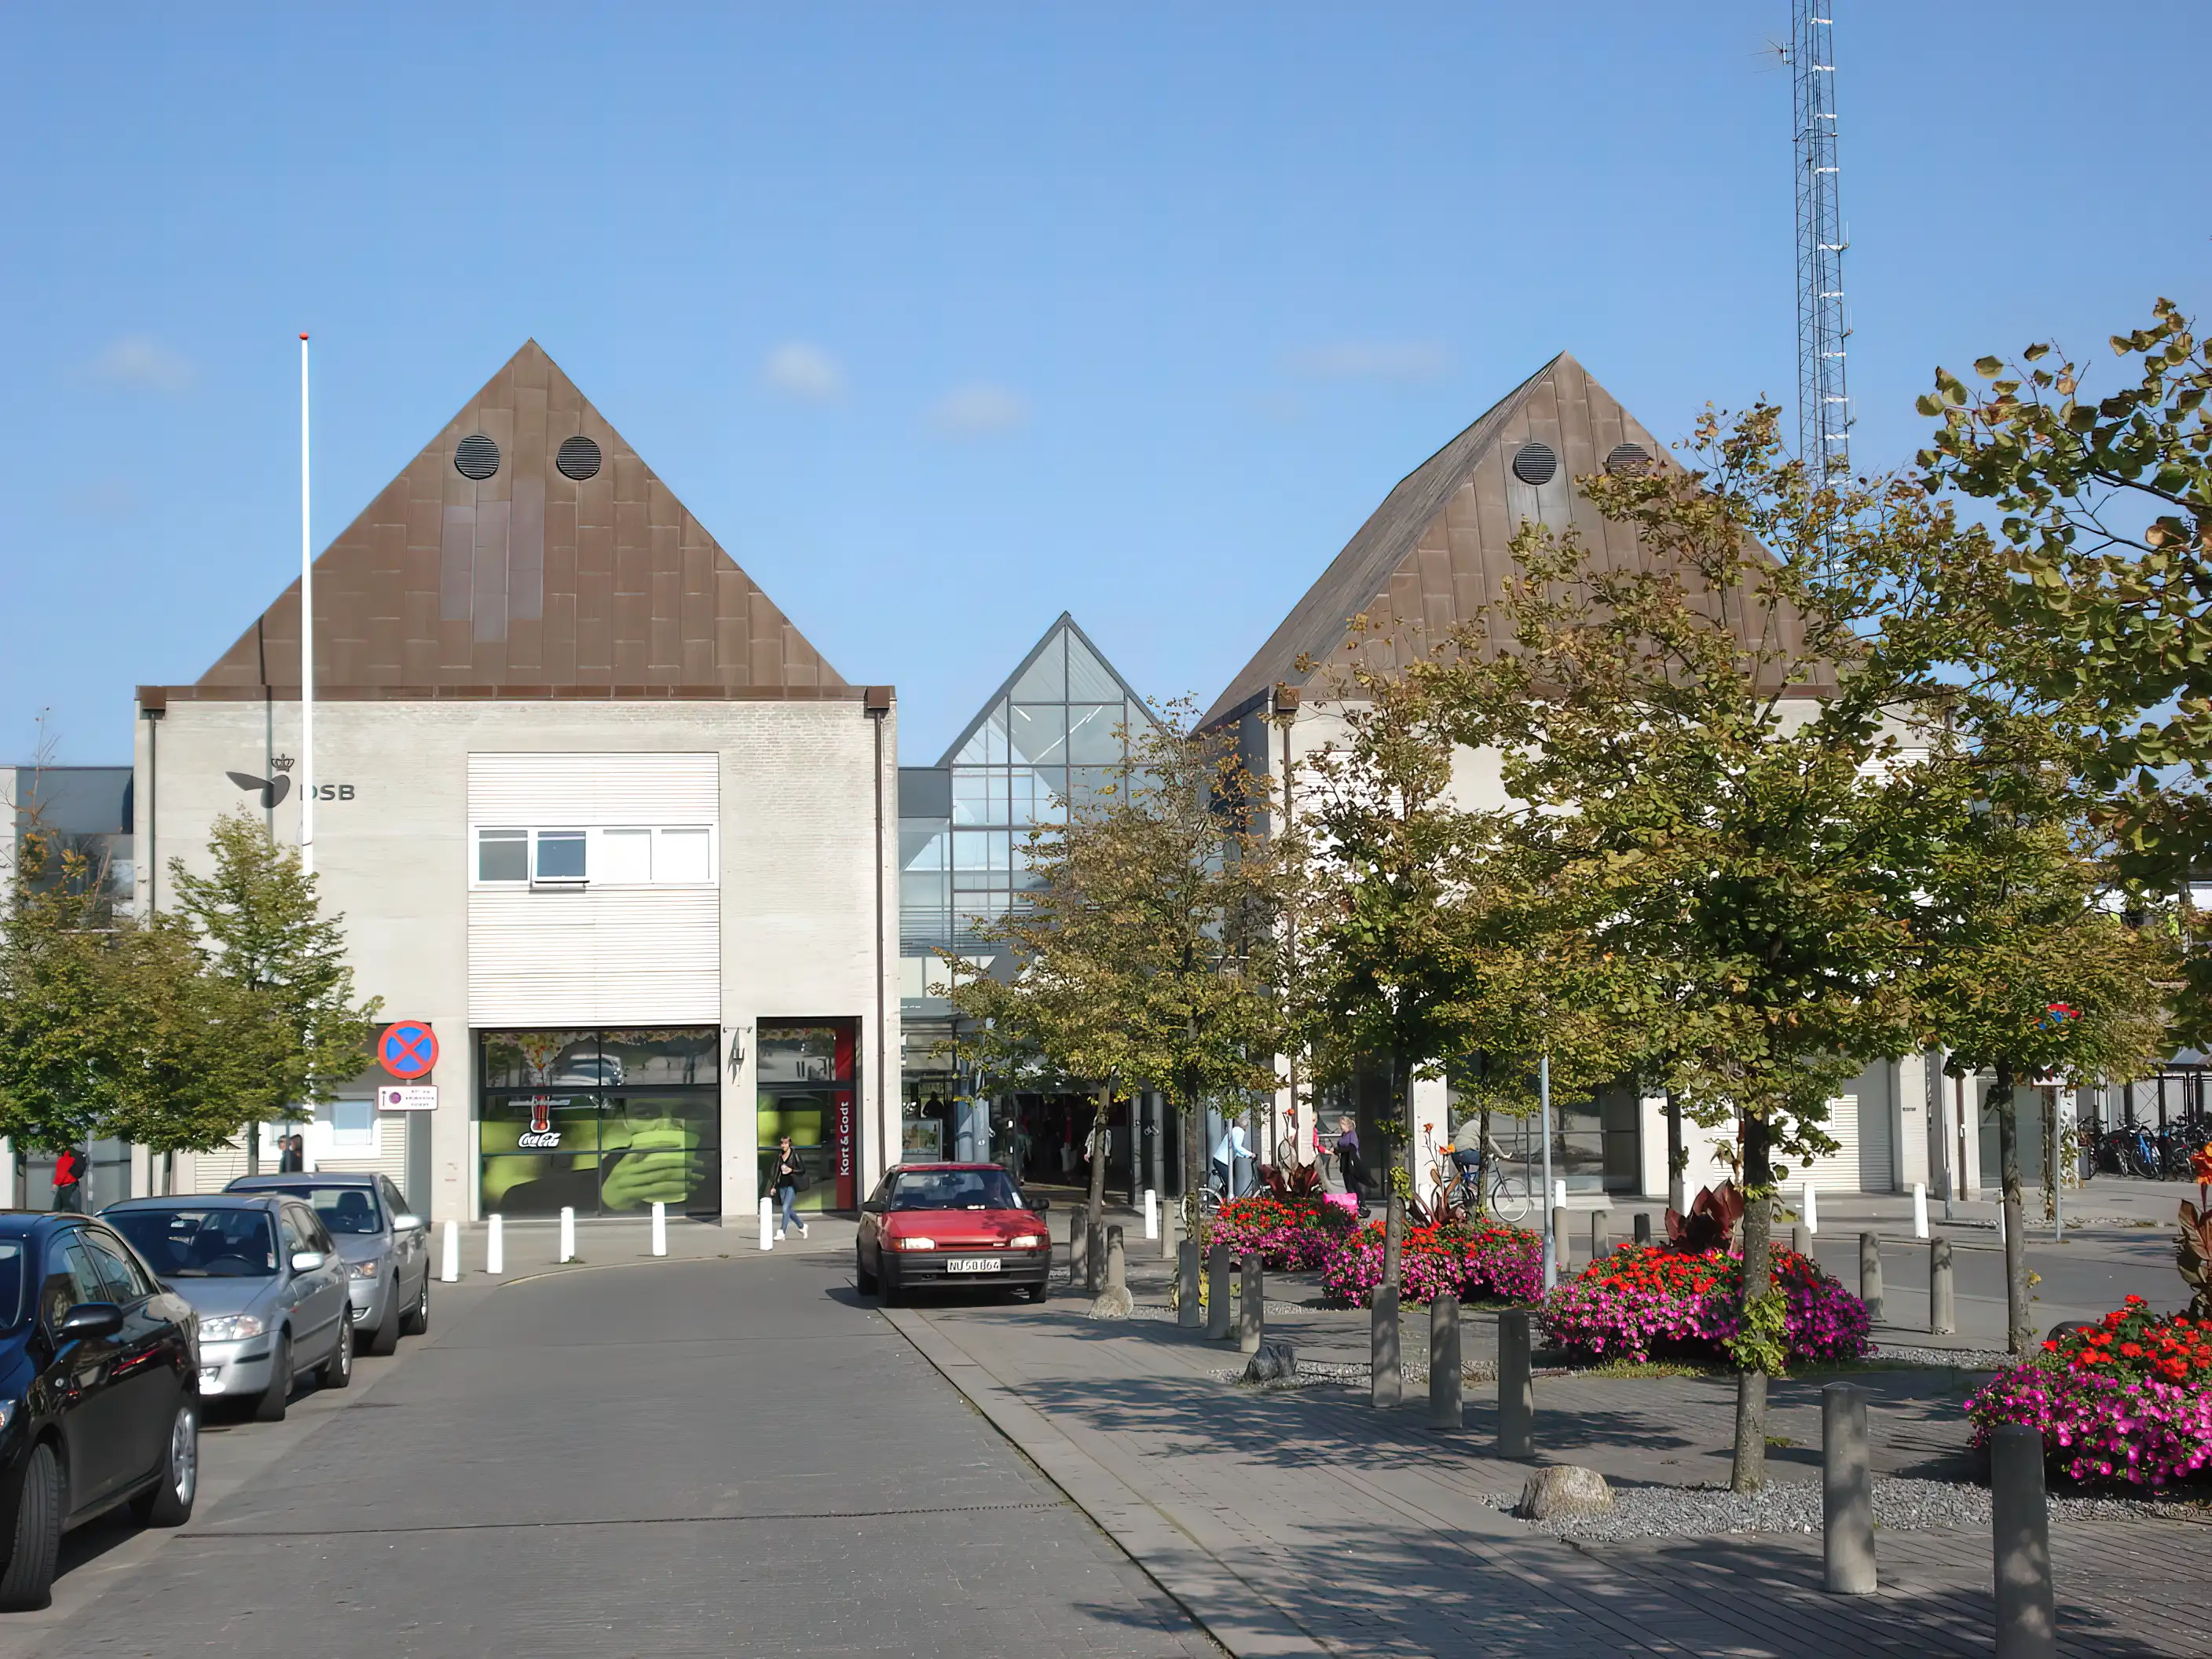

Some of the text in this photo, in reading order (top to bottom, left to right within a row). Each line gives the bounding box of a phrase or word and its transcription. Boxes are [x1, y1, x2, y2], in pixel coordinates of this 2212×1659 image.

[840, 1101, 849, 1176] Kort & Godt
